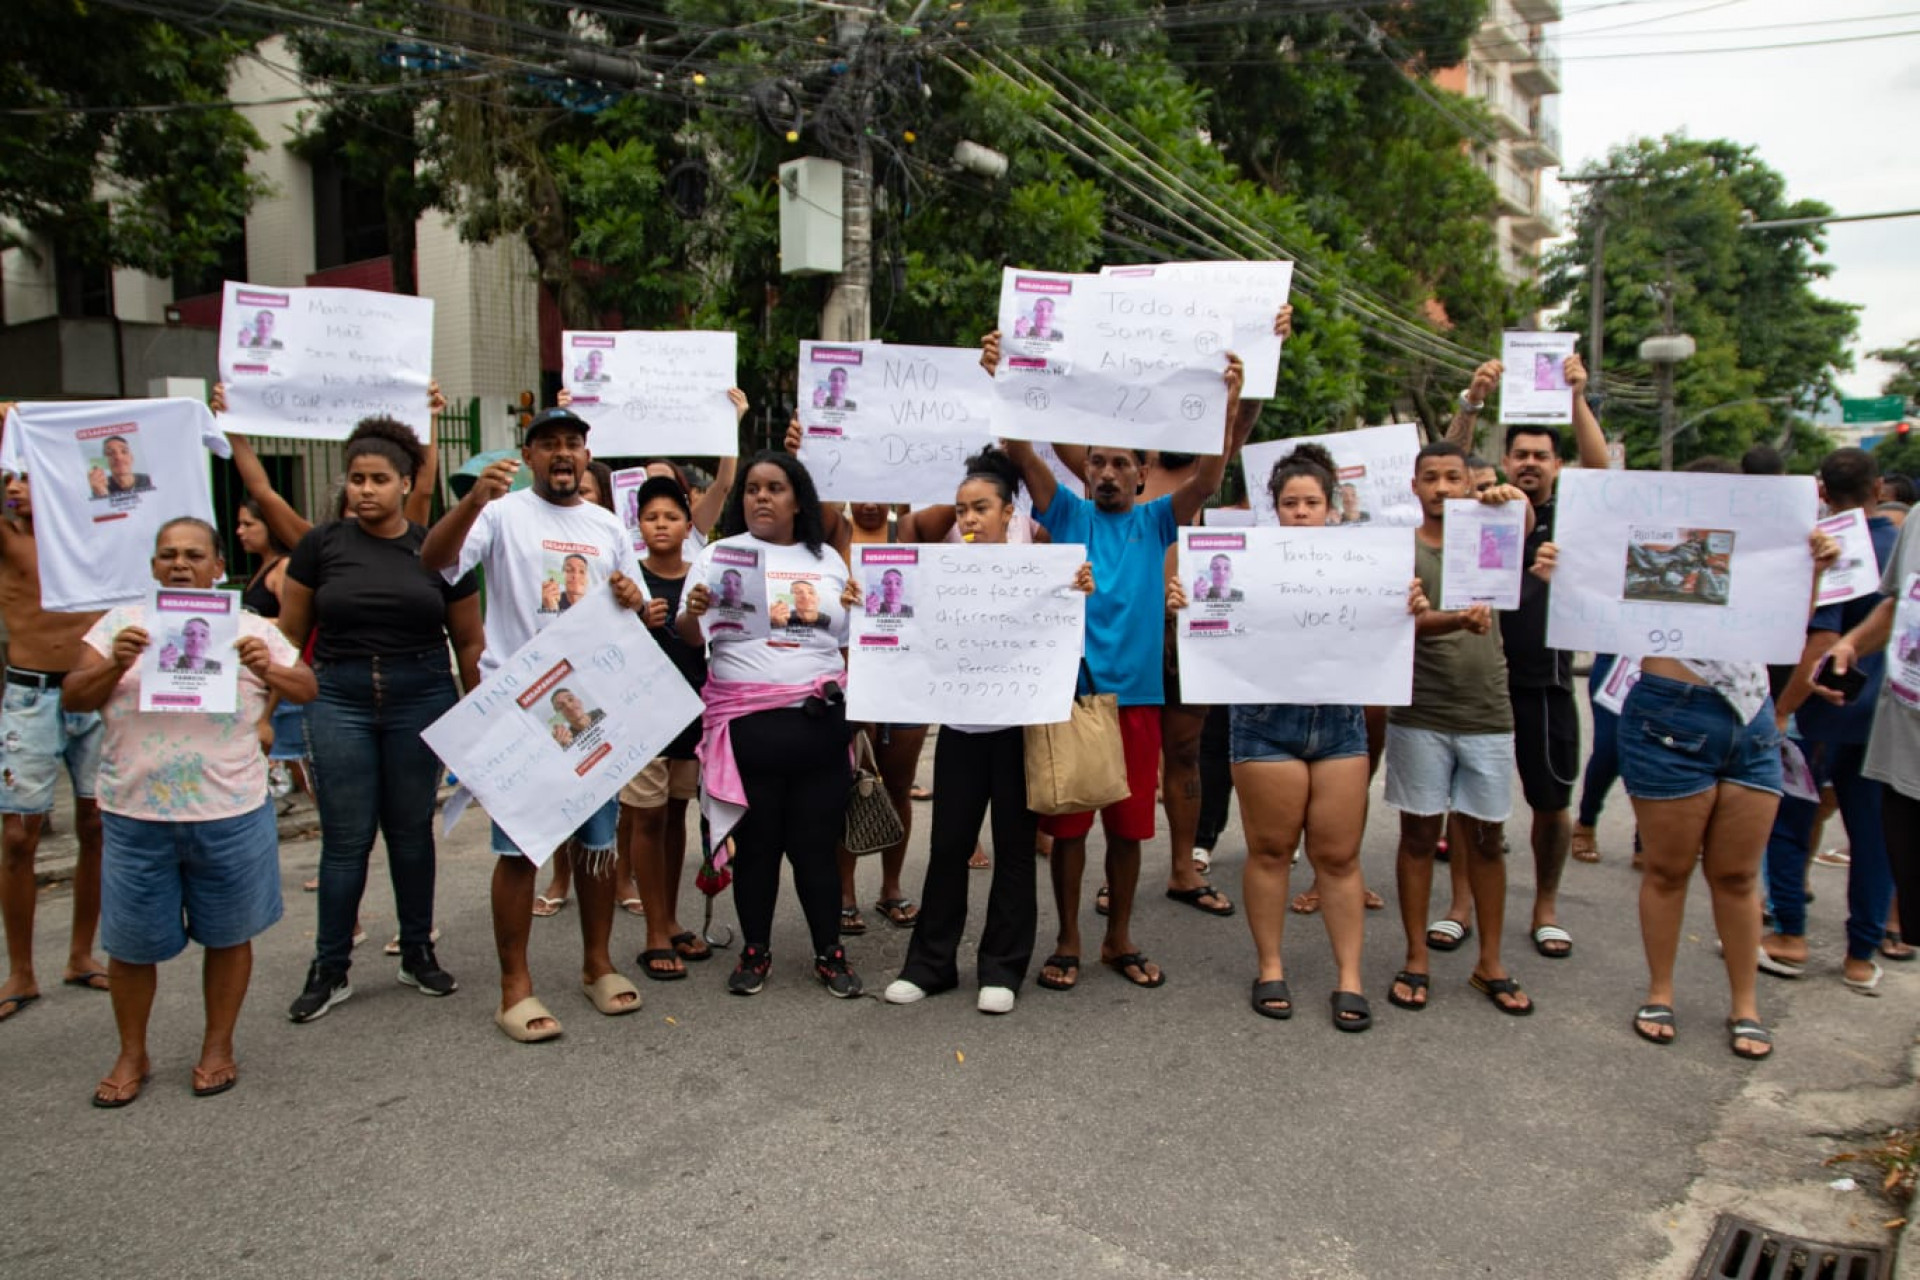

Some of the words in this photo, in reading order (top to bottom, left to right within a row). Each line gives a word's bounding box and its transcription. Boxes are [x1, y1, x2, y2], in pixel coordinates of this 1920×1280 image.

[1096, 291, 1174, 316] Todo
[1096, 322, 1178, 345] Some
[883, 357, 940, 391] NÃO
[889, 399, 970, 425] VAMOS
[828, 449, 842, 487] ?
[940, 554, 982, 574] Sua
[936, 584, 978, 602] pode
[989, 583, 1041, 602] fazer
[936, 608, 1020, 629] diferença
[1033, 611, 1079, 627] entre
[958, 638, 1022, 651] espera
[1649, 629, 1684, 652] 99
[957, 657, 1042, 676] Reencontro
